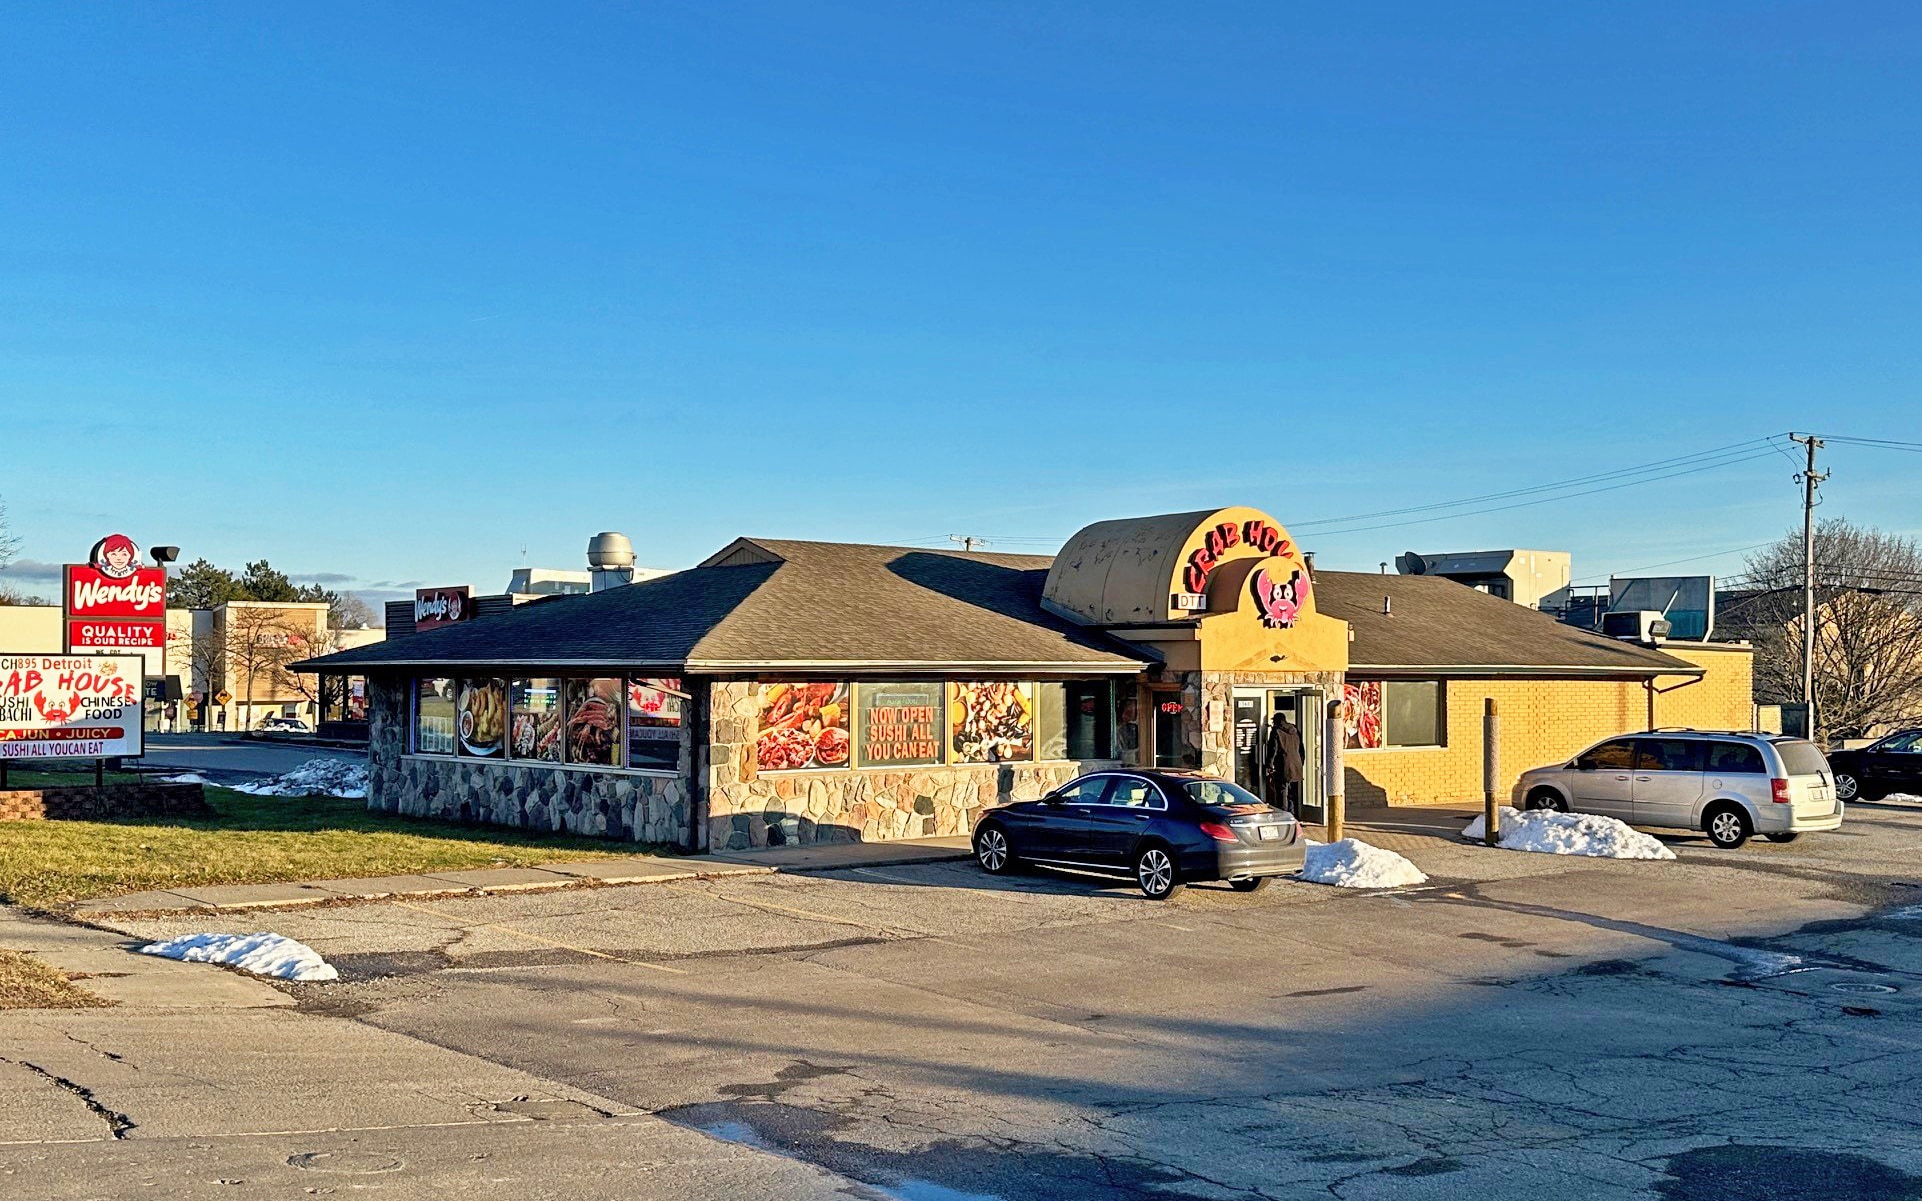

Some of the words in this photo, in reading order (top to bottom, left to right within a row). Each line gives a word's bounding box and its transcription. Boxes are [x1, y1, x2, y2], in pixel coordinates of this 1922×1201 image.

[1183, 522, 1240, 594] CRAB
[1243, 520, 1294, 559] HOU
[74, 575, 163, 611] Wendy's
[415, 592, 447, 623] Wendy's
[81, 625, 154, 638] QUALITY
[81, 637, 92, 645] IS
[94, 637, 115, 645] OUR
[118, 637, 154, 646] RECIPE
[42, 657, 92, 670] Detroit
[0, 669, 44, 698] AB
[58, 669, 138, 705] HOUSE
[80, 696, 131, 708] CHINESE
[1161, 702, 1184, 714] OPEN
[85, 708, 123, 719] FOOD
[867, 707, 898, 725] NOW
[901, 706, 934, 723] OPEN
[66, 728, 111, 739] JUICY
[870, 724, 907, 742] SUSHI
[911, 723, 934, 740] ALL
[2, 743, 29, 757] SUSHI
[31, 742, 47, 756] ALL
[88, 741, 104, 755] EAT
[865, 742, 891, 760] YOU
[893, 741, 917, 759] CAN
[918, 741, 940, 758] EAT
